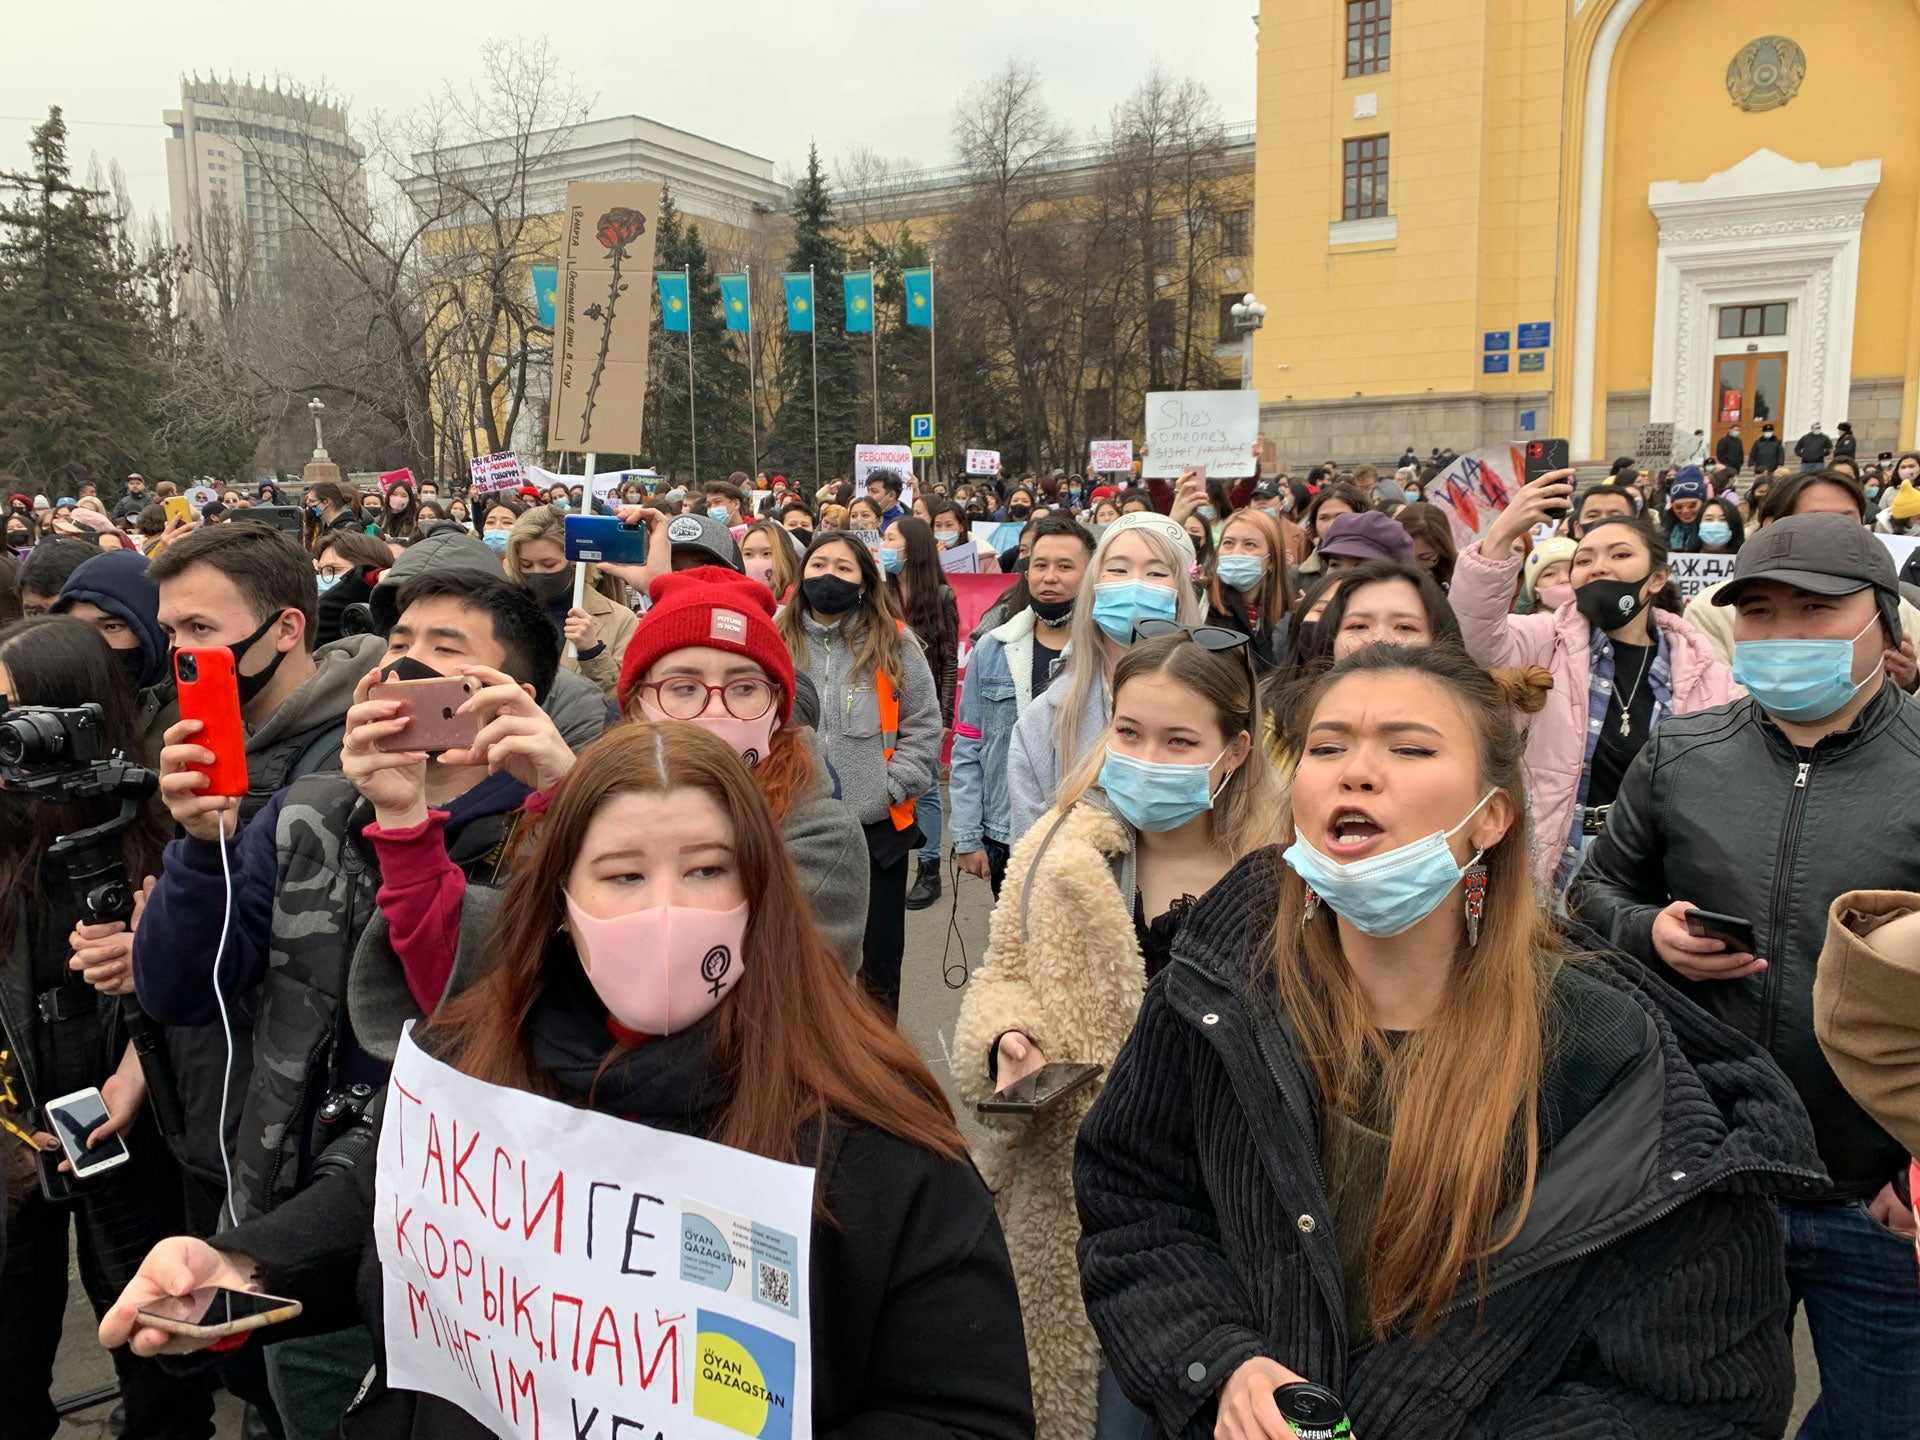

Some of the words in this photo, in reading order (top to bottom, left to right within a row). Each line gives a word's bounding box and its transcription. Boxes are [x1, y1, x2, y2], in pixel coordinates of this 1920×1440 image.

[1157, 400, 1211, 431] She's
[1150, 429, 1228, 446] someone's
[858, 451, 911, 464] РЕВОЛЮЦИЯ
[717, 615, 742, 626] FUTURE
[724, 623, 742, 633] NOW
[684, 1241, 747, 1269] QAZAQSTAN
[702, 1367, 785, 1409] QAZAQSTAN
[1296, 1427, 1333, 1440] CAFFEINE
